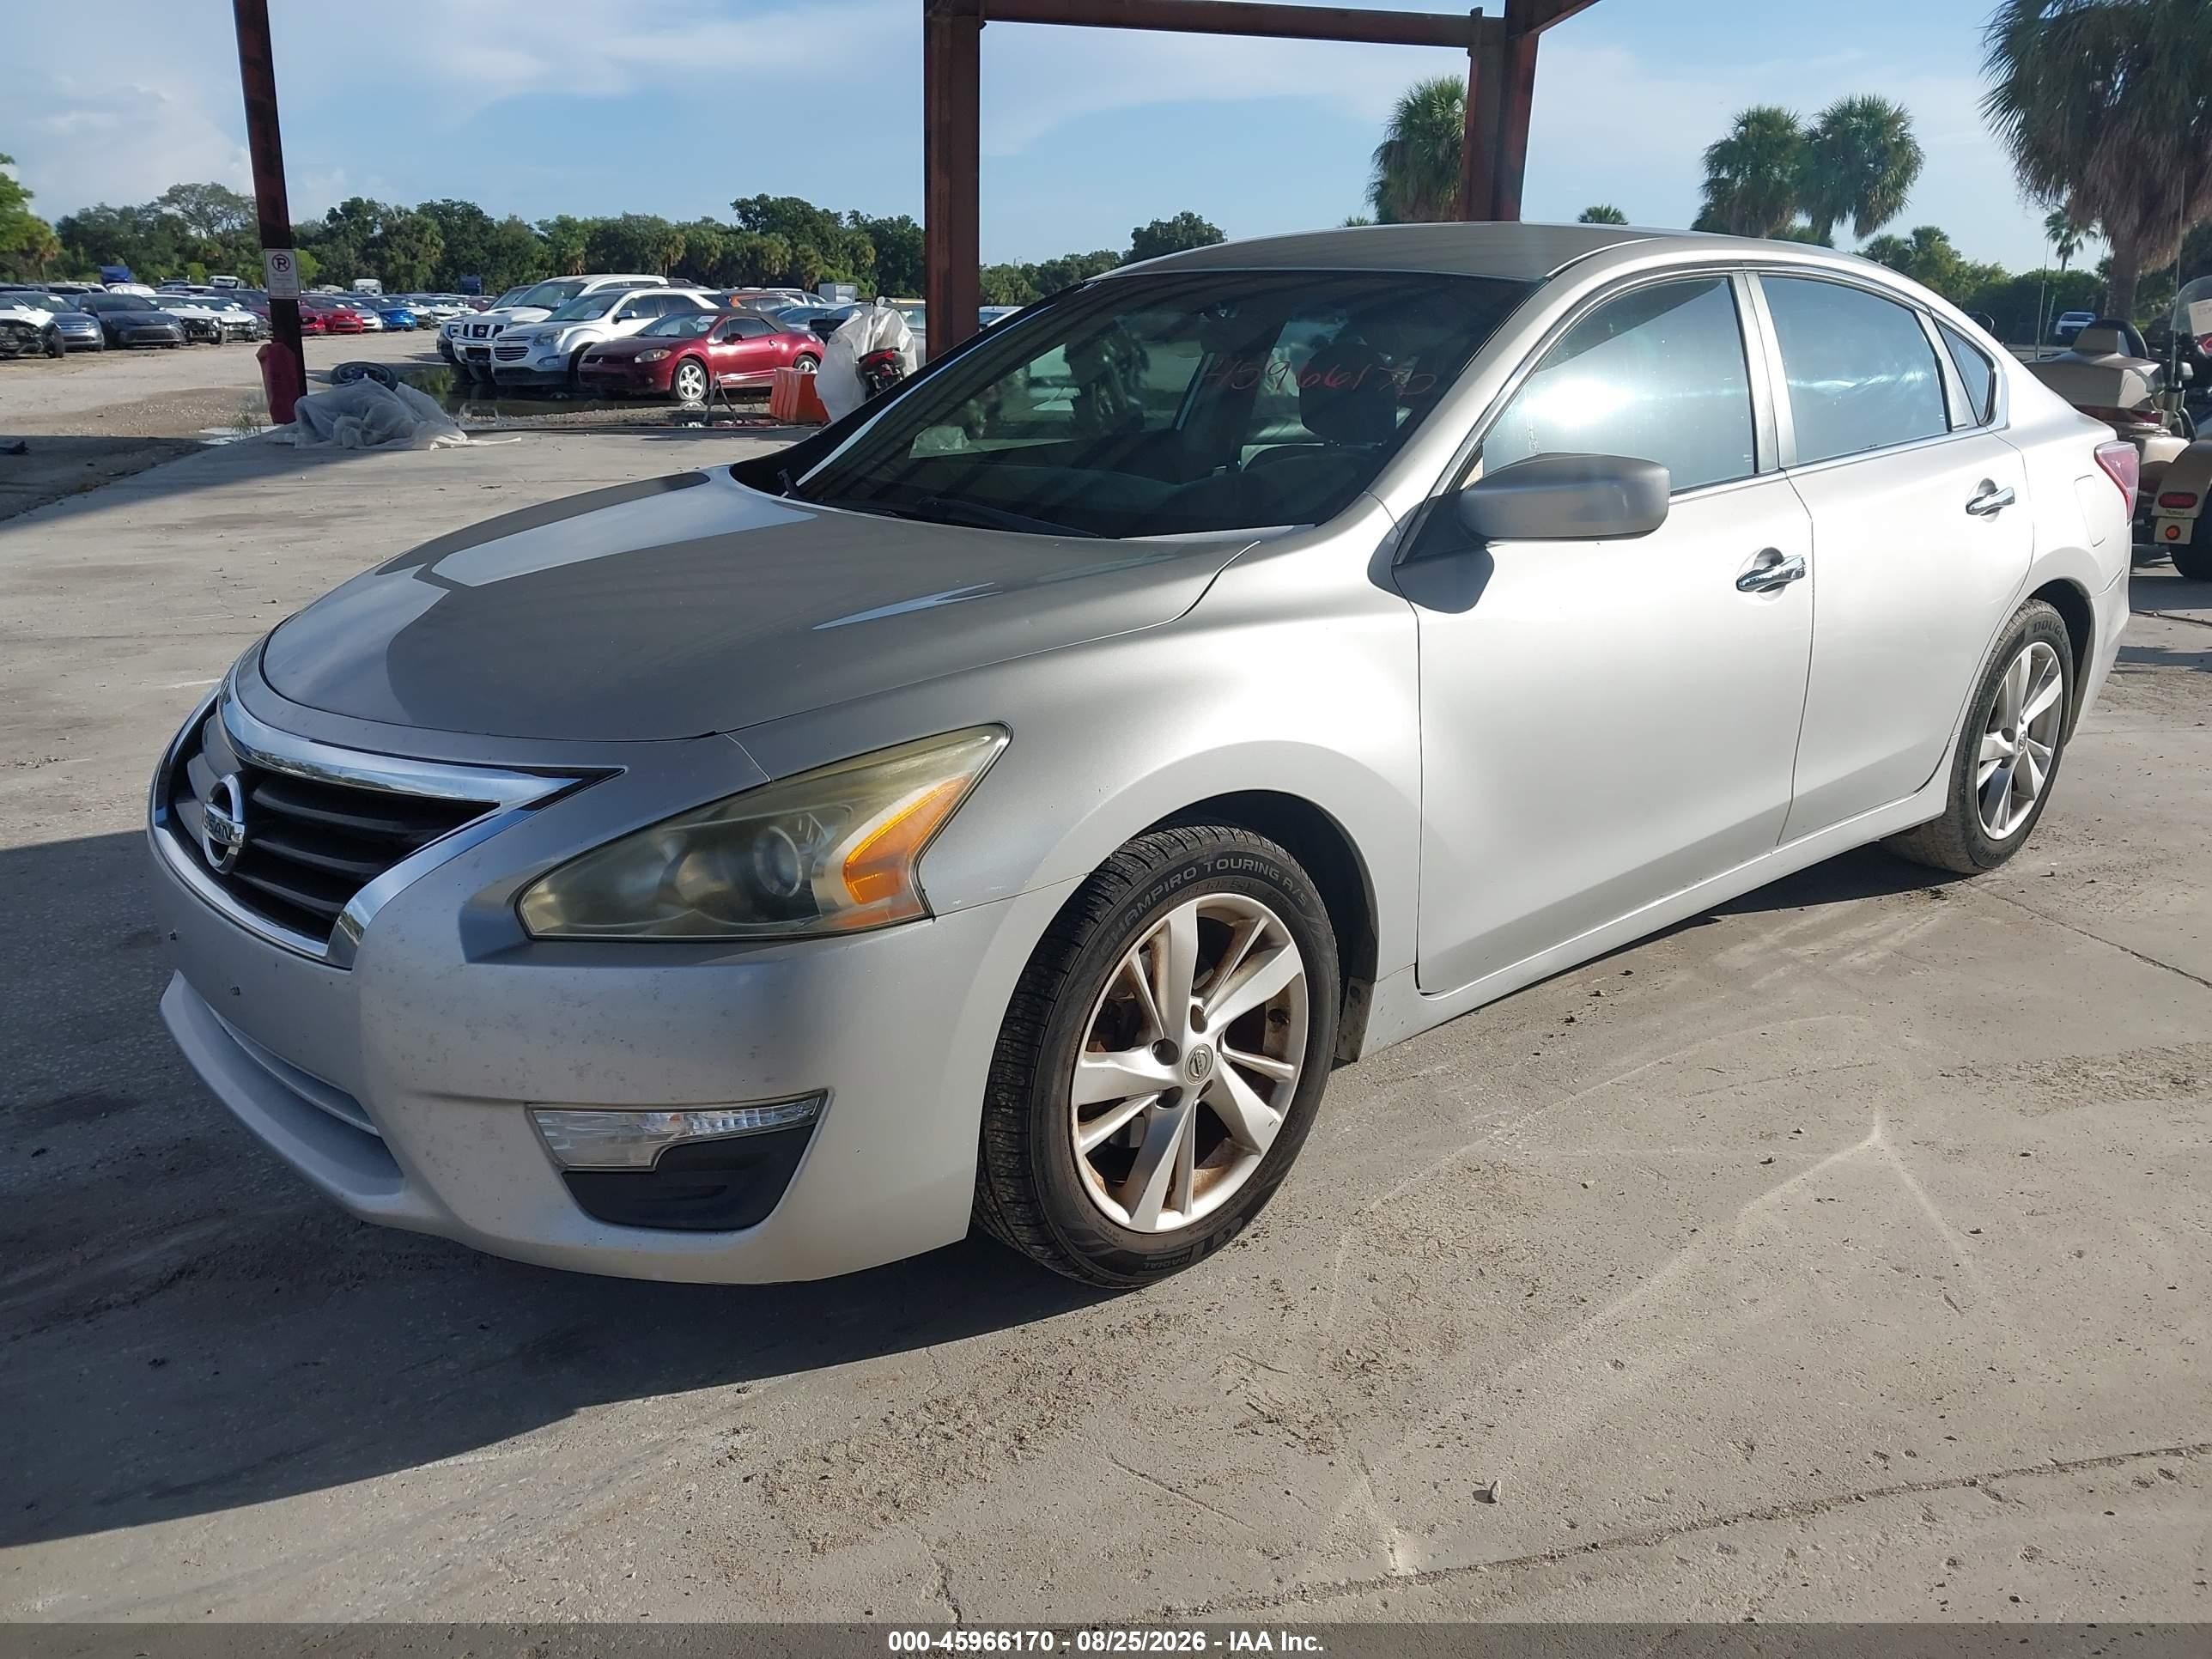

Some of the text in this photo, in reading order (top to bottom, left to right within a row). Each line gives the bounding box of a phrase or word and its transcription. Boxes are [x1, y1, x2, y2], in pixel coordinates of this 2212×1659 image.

[1098, 866, 1197, 955] CHAMPIRO
[1205, 858, 1280, 879] TOURING
[1282, 878, 1307, 908] A/S
[1143, 1254, 1191, 1270] RADIAL
